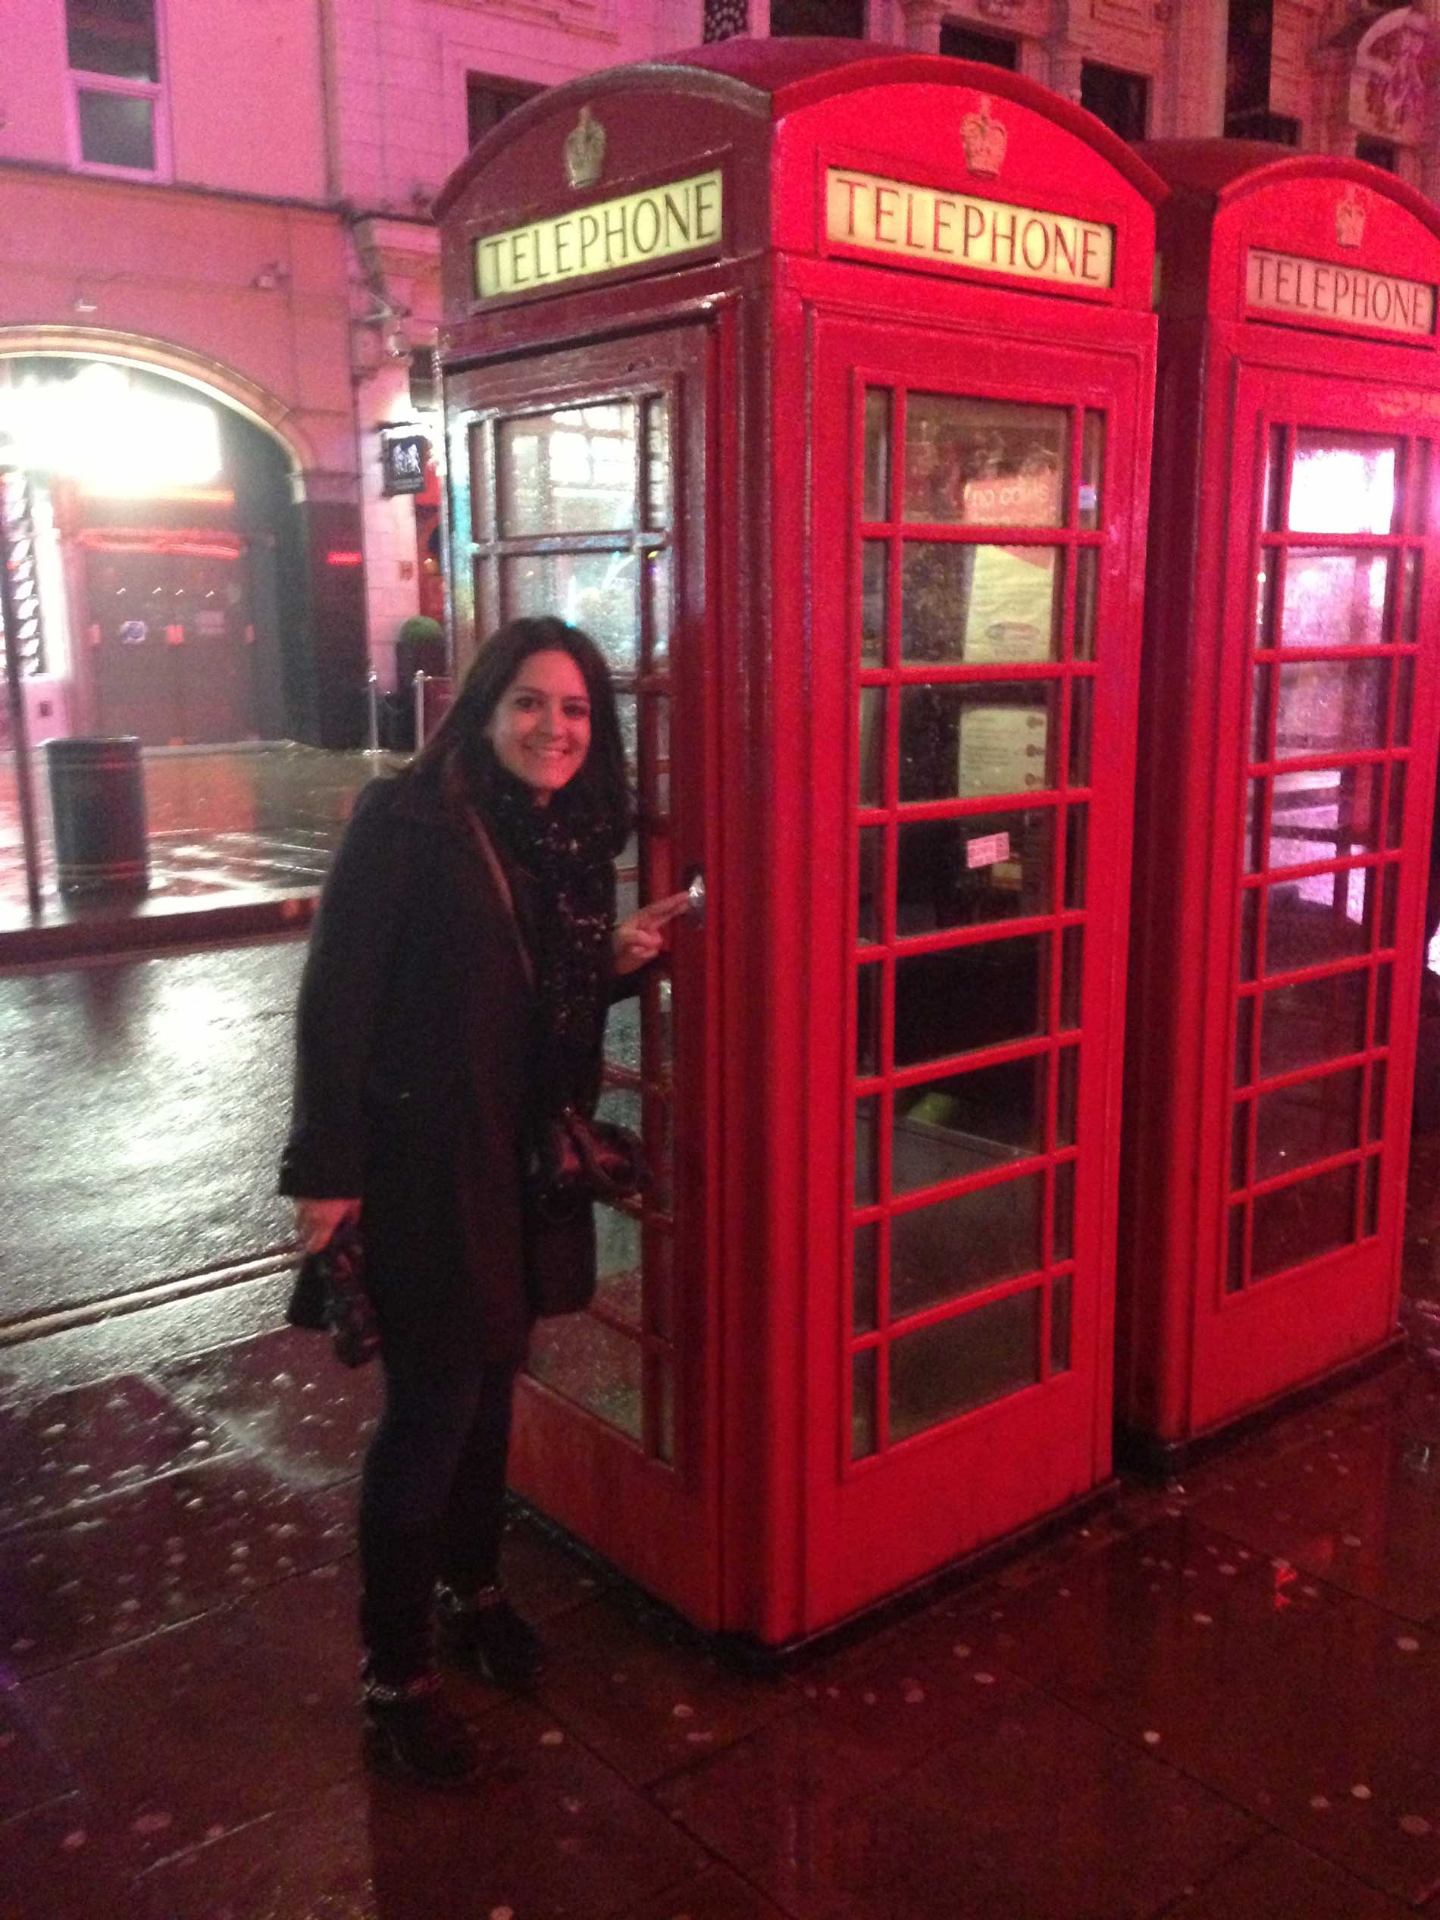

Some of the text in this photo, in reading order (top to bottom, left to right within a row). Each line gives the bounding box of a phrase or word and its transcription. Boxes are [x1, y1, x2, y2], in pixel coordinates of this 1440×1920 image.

[485, 179, 718, 289] TELEPHONE
[836, 178, 1102, 281] TELEPHONE
[1252, 254, 1427, 329] TELEPHONE
